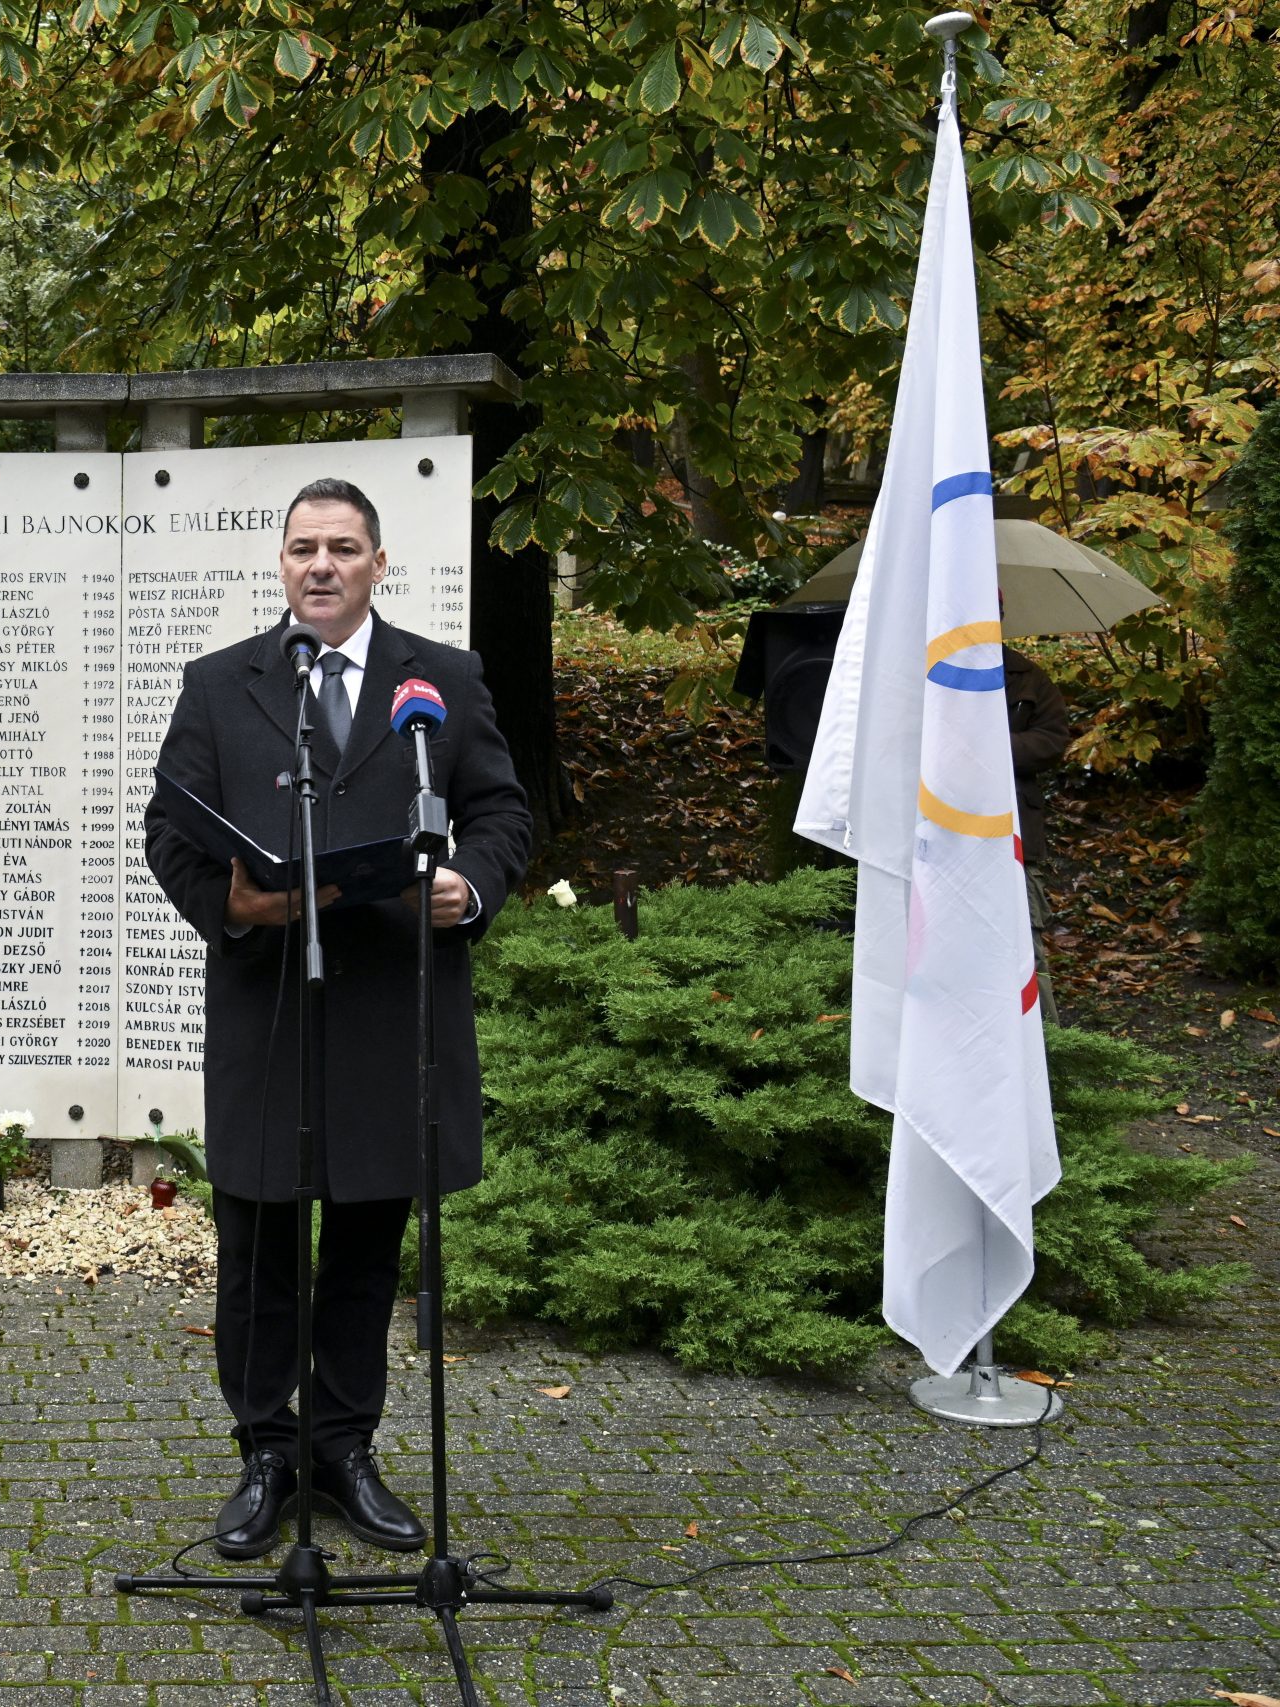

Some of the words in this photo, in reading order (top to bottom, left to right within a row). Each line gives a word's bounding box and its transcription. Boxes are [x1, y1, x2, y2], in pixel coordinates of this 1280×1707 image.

[22, 514, 157, 535] BAJNOKOK
[29, 572, 67, 584] ERVIN
[128, 570, 198, 584] PETSCHAUER
[202, 569, 246, 582] ATTILA
[128, 589, 166, 601] WEISZ
[0, 784, 44, 796] ANTAL
[125, 908, 170, 923] POLYÁK
[17, 926, 54, 938] JUDIT
[126, 928, 165, 940] TEMES
[126, 946, 166, 959] FELKAI
[126, 962, 174, 978] KONRÁD
[126, 982, 173, 996] SZONDY
[126, 999, 182, 1014] KULCSÁR
[124, 1020, 176, 1033] AMBRUS
[126, 1038, 182, 1052] BENEDEK
[8, 1054, 73, 1066] SZILVESZTER
[126, 1057, 173, 1070] MAROSI
